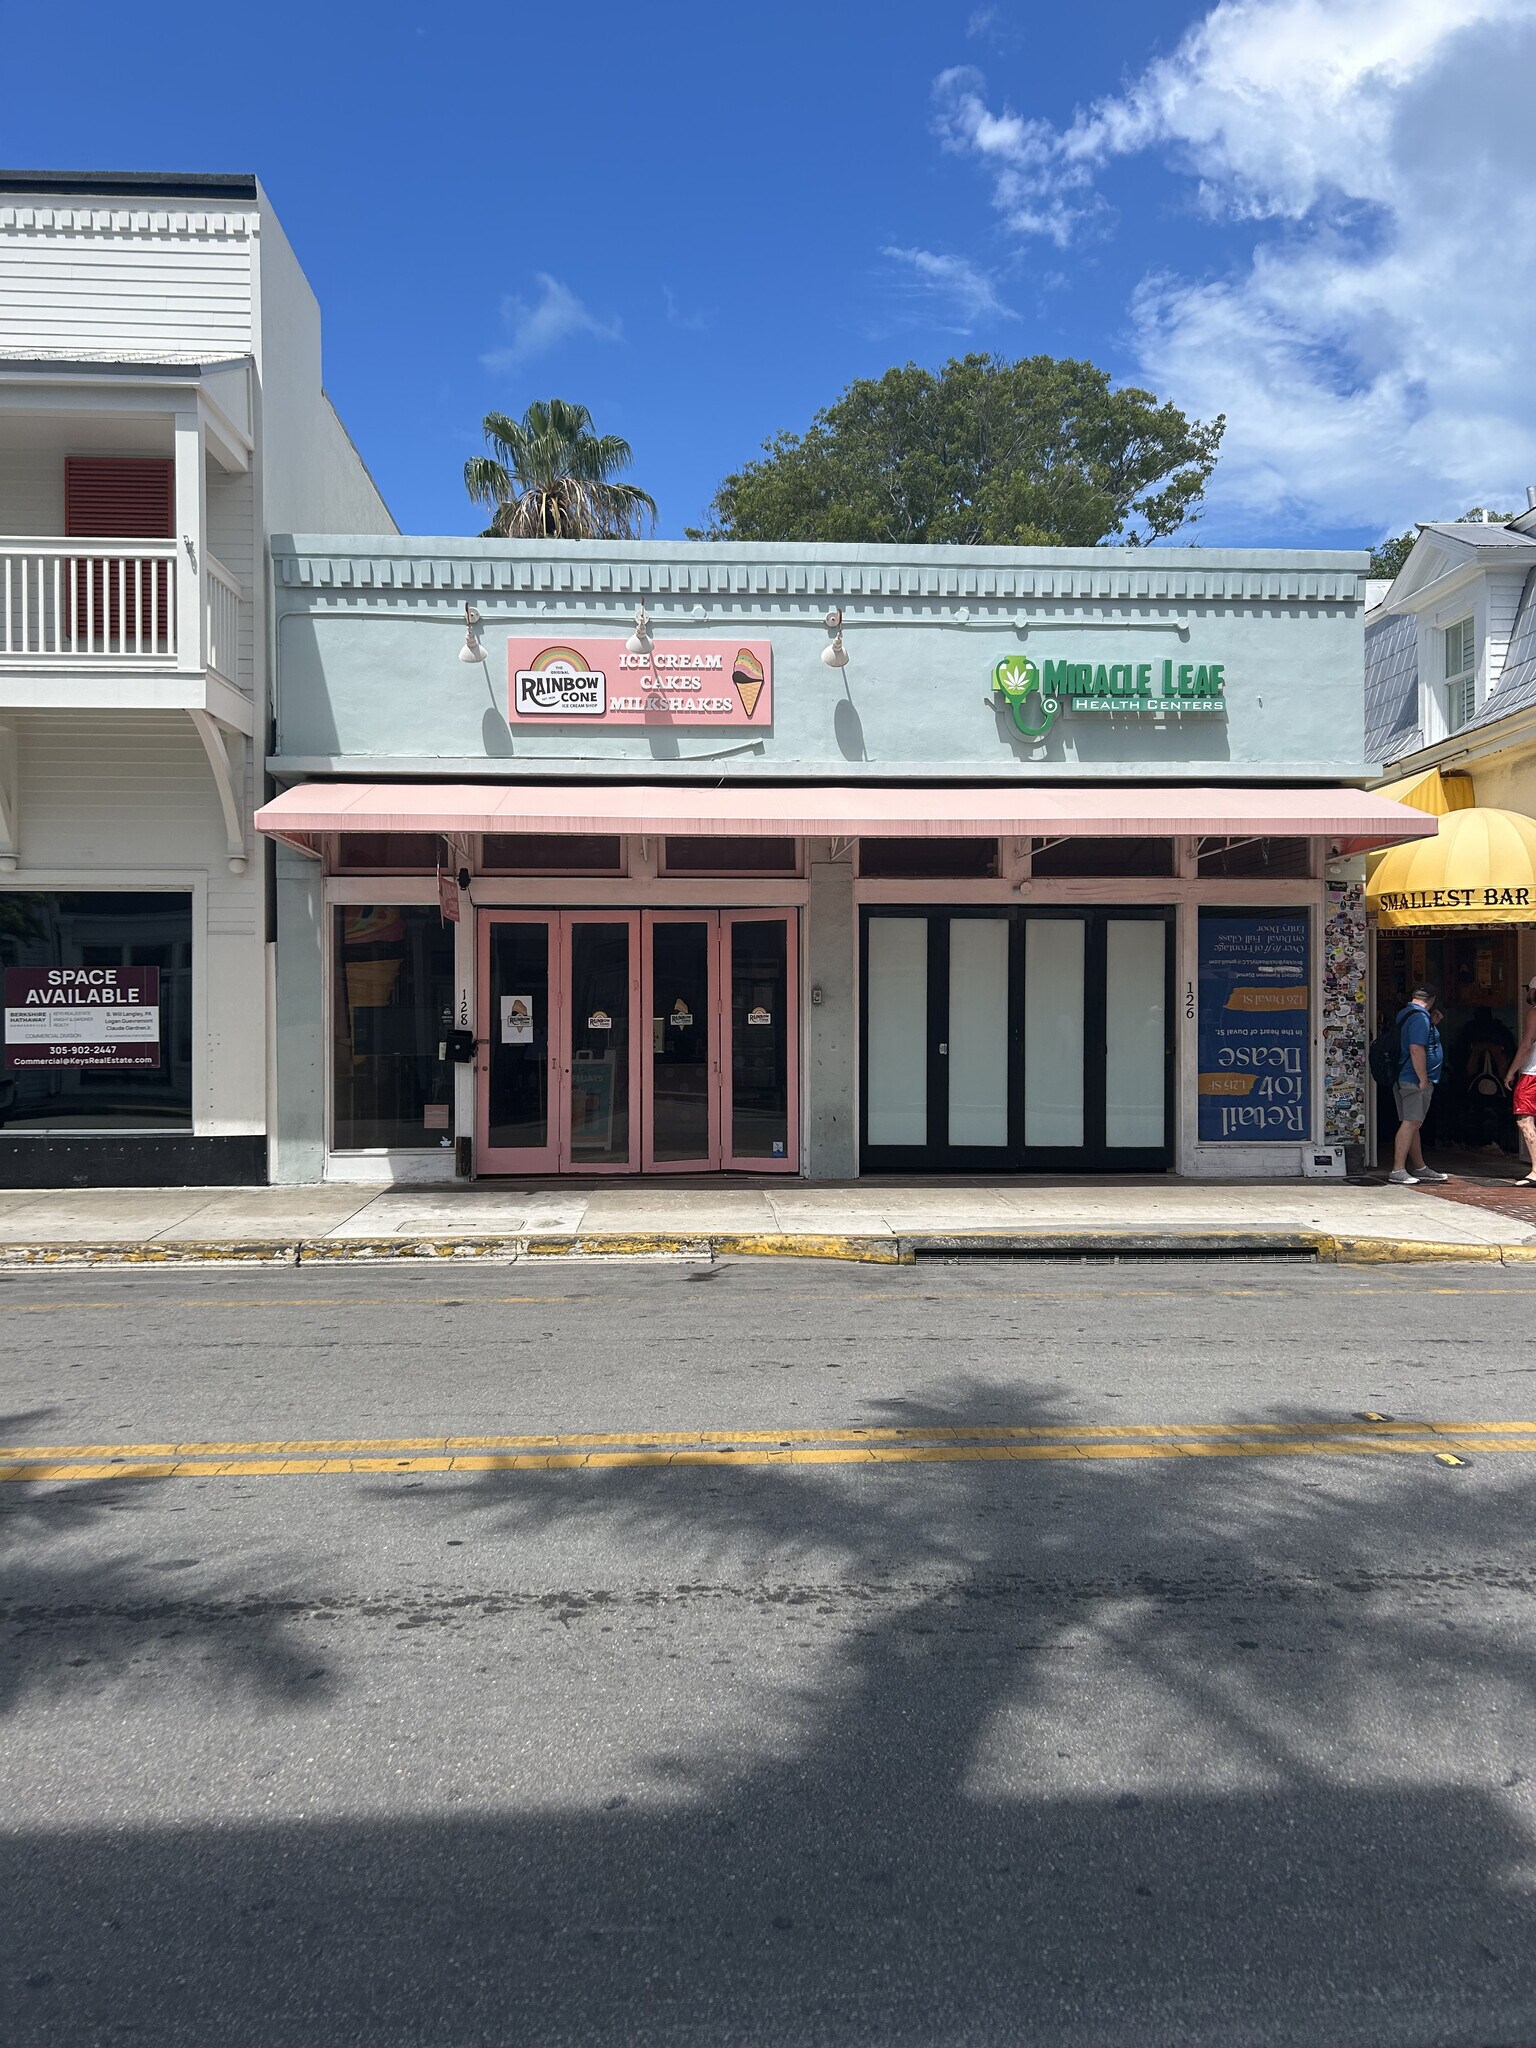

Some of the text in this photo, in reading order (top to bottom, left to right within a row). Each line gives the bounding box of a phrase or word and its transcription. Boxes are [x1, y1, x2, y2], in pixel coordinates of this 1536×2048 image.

[619, 654, 723, 669] ICE CREAM
[640, 676, 702, 690] CAKES
[1043, 660, 1225, 695] MIRACLE LEAF
[521, 677, 599, 707] RAINBOW
[561, 692, 598, 702] CONE
[609, 697, 733, 711] MILKSHAKES
[1076, 700, 1224, 710] HEALTH CENTERS
[1379, 887, 1530, 912] SMALLEST BAR
[1257, 924, 1304, 933] Entry Door
[1218, 935, 1241, 943] Glass
[1245, 935, 1260, 943] Full
[1214, 942, 1252, 953] Frontage
[1253, 945, 1263, 953] of
[1284, 945, 1304, 953] Over
[48, 970, 118, 985] SPACE
[25, 988, 140, 1004] AVAILABLE
[1186, 982, 1194, 1018] 126
[1240, 995, 1303, 1005] 126 Duval St.
[460, 988, 468, 1026] 128
[50, 1046, 117, 1055] 305-902-2447
[14, 1057, 152, 1066] Commercial@KeysRealEstate.com
[1209, 1080, 1246, 1090] 1,215 SF
[1221, 1106, 1304, 1135] Retail
